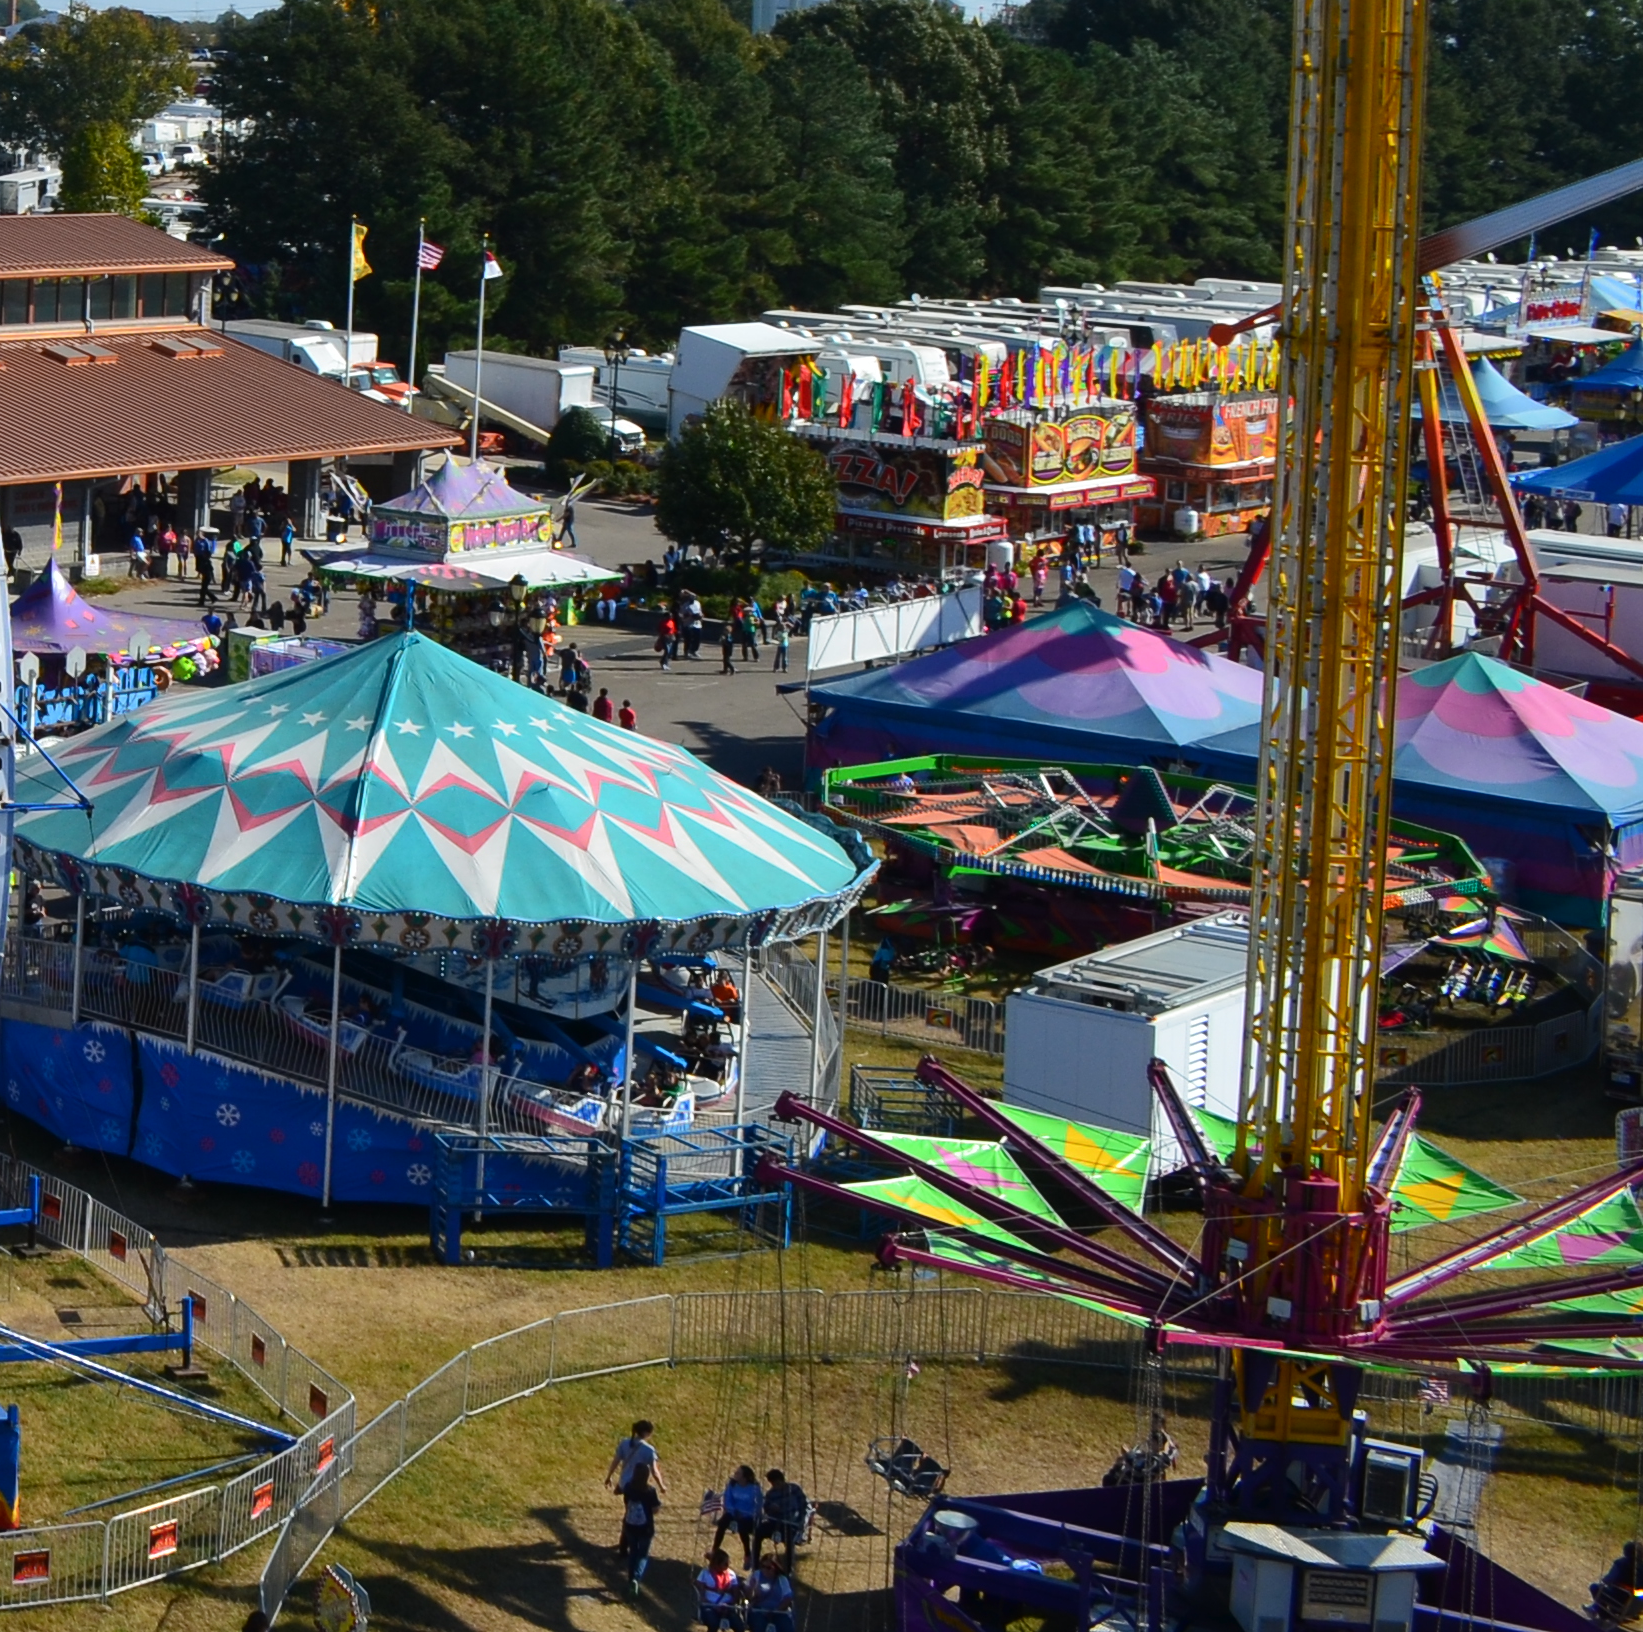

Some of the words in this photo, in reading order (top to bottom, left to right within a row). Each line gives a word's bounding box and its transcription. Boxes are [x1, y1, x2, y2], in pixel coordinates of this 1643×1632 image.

[1225, 400, 1261, 419] FRENCH
[832, 455, 919, 505] ZZA!
[886, 523, 926, 536] Pretzels
